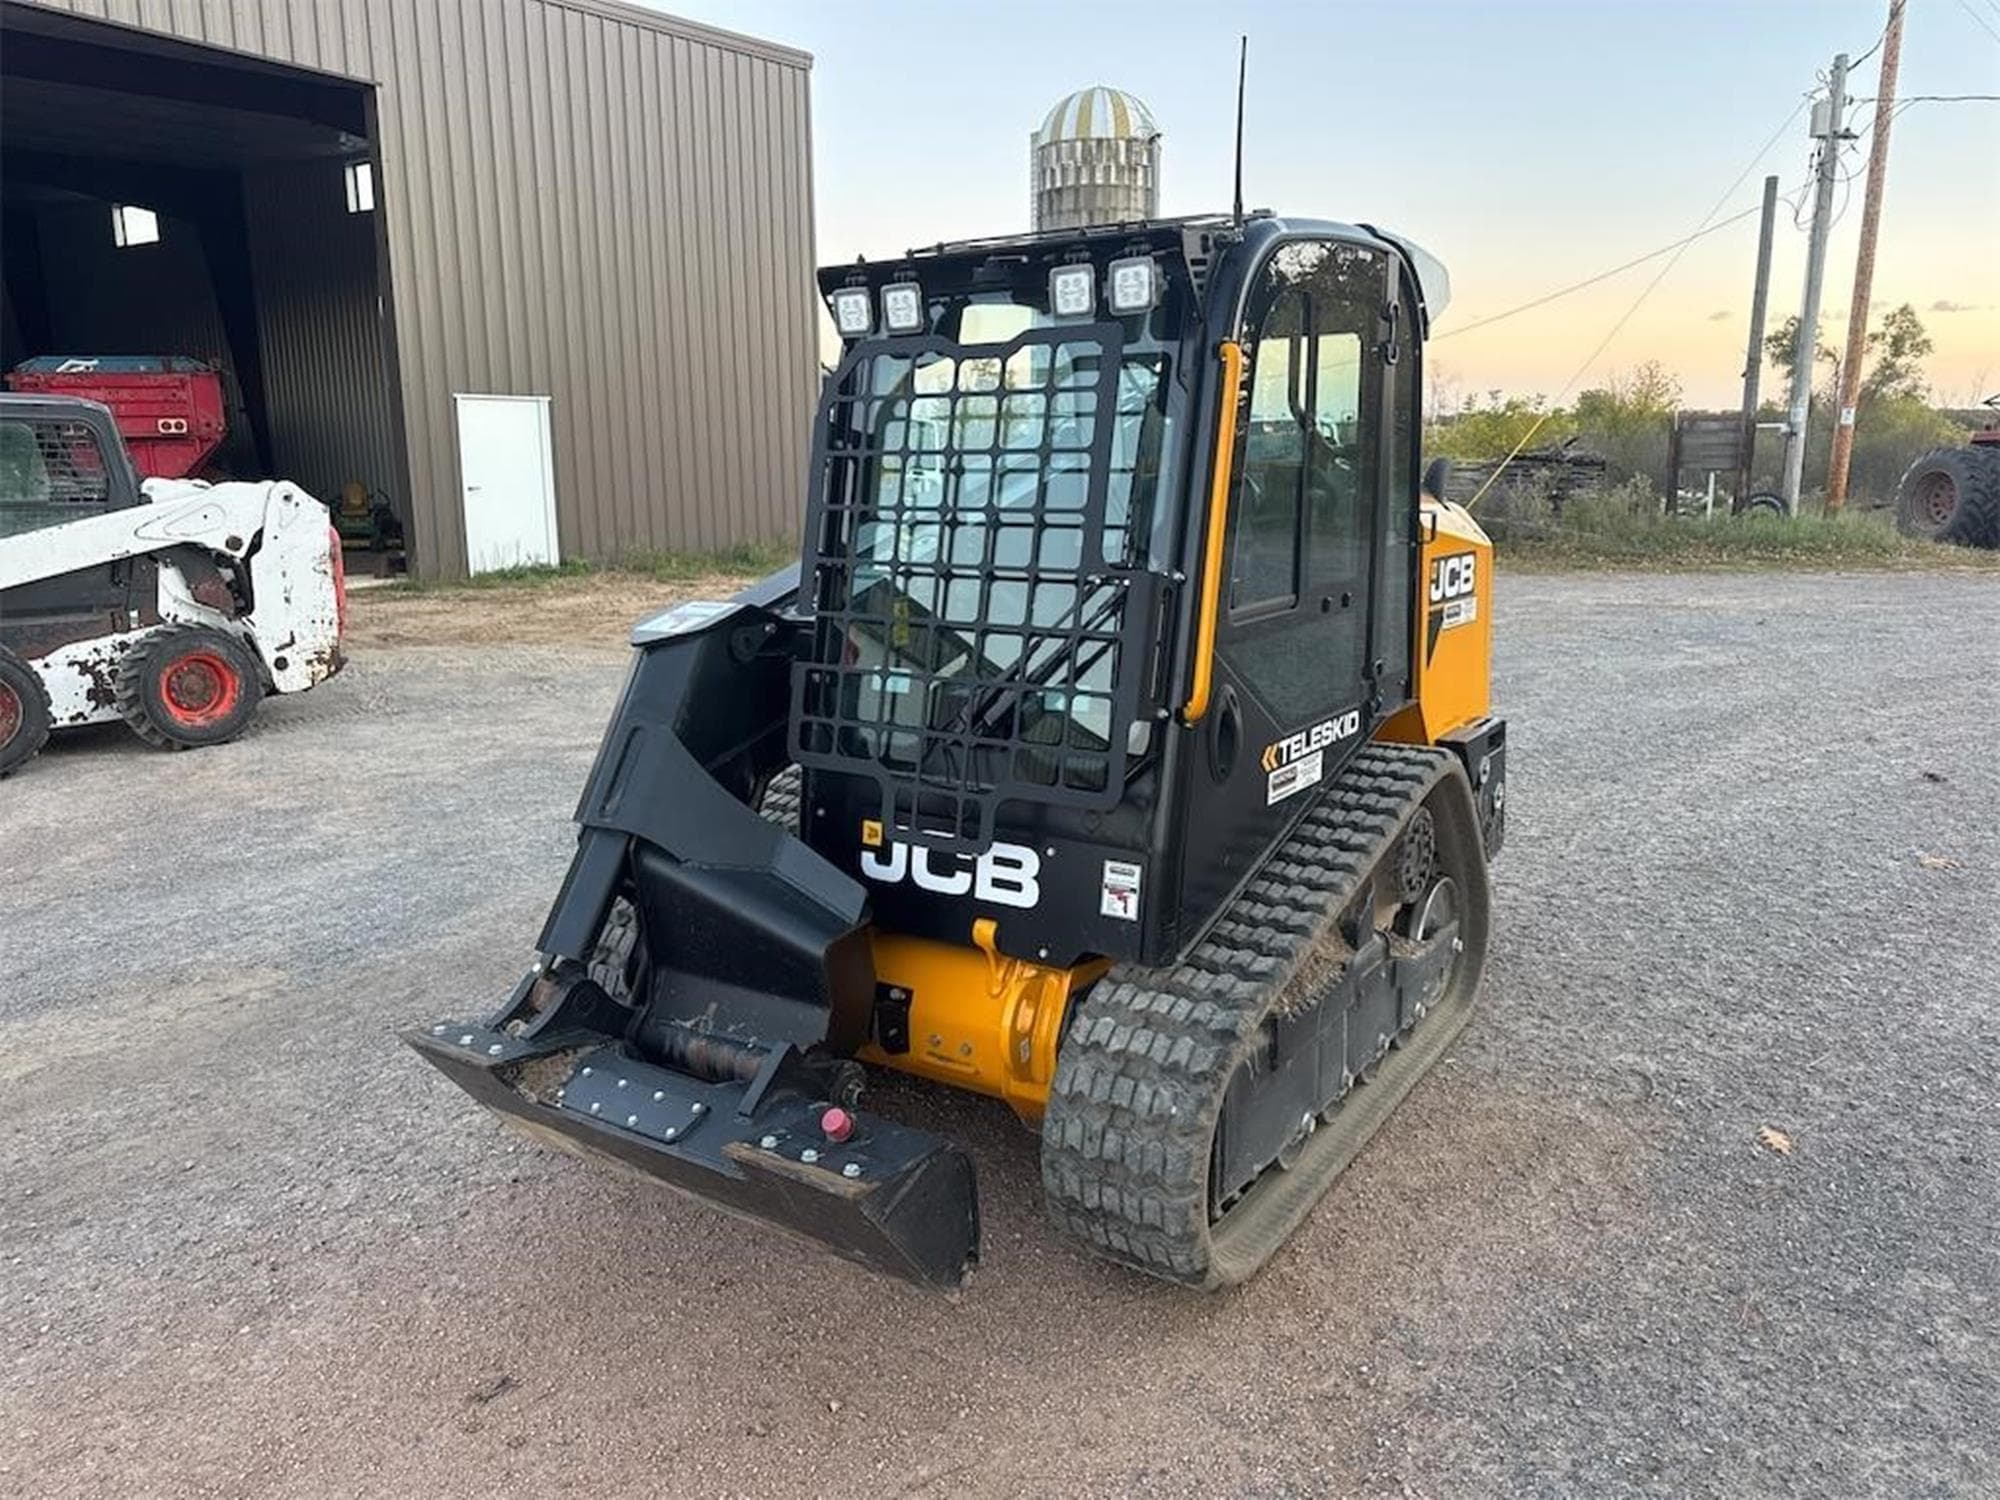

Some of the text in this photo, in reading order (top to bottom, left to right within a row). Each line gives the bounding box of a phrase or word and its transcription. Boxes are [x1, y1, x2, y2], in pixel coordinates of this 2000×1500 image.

[1431, 554, 1475, 601] JCB
[1279, 710, 1359, 765] TELESKID
[861, 826, 1040, 909] JCB
